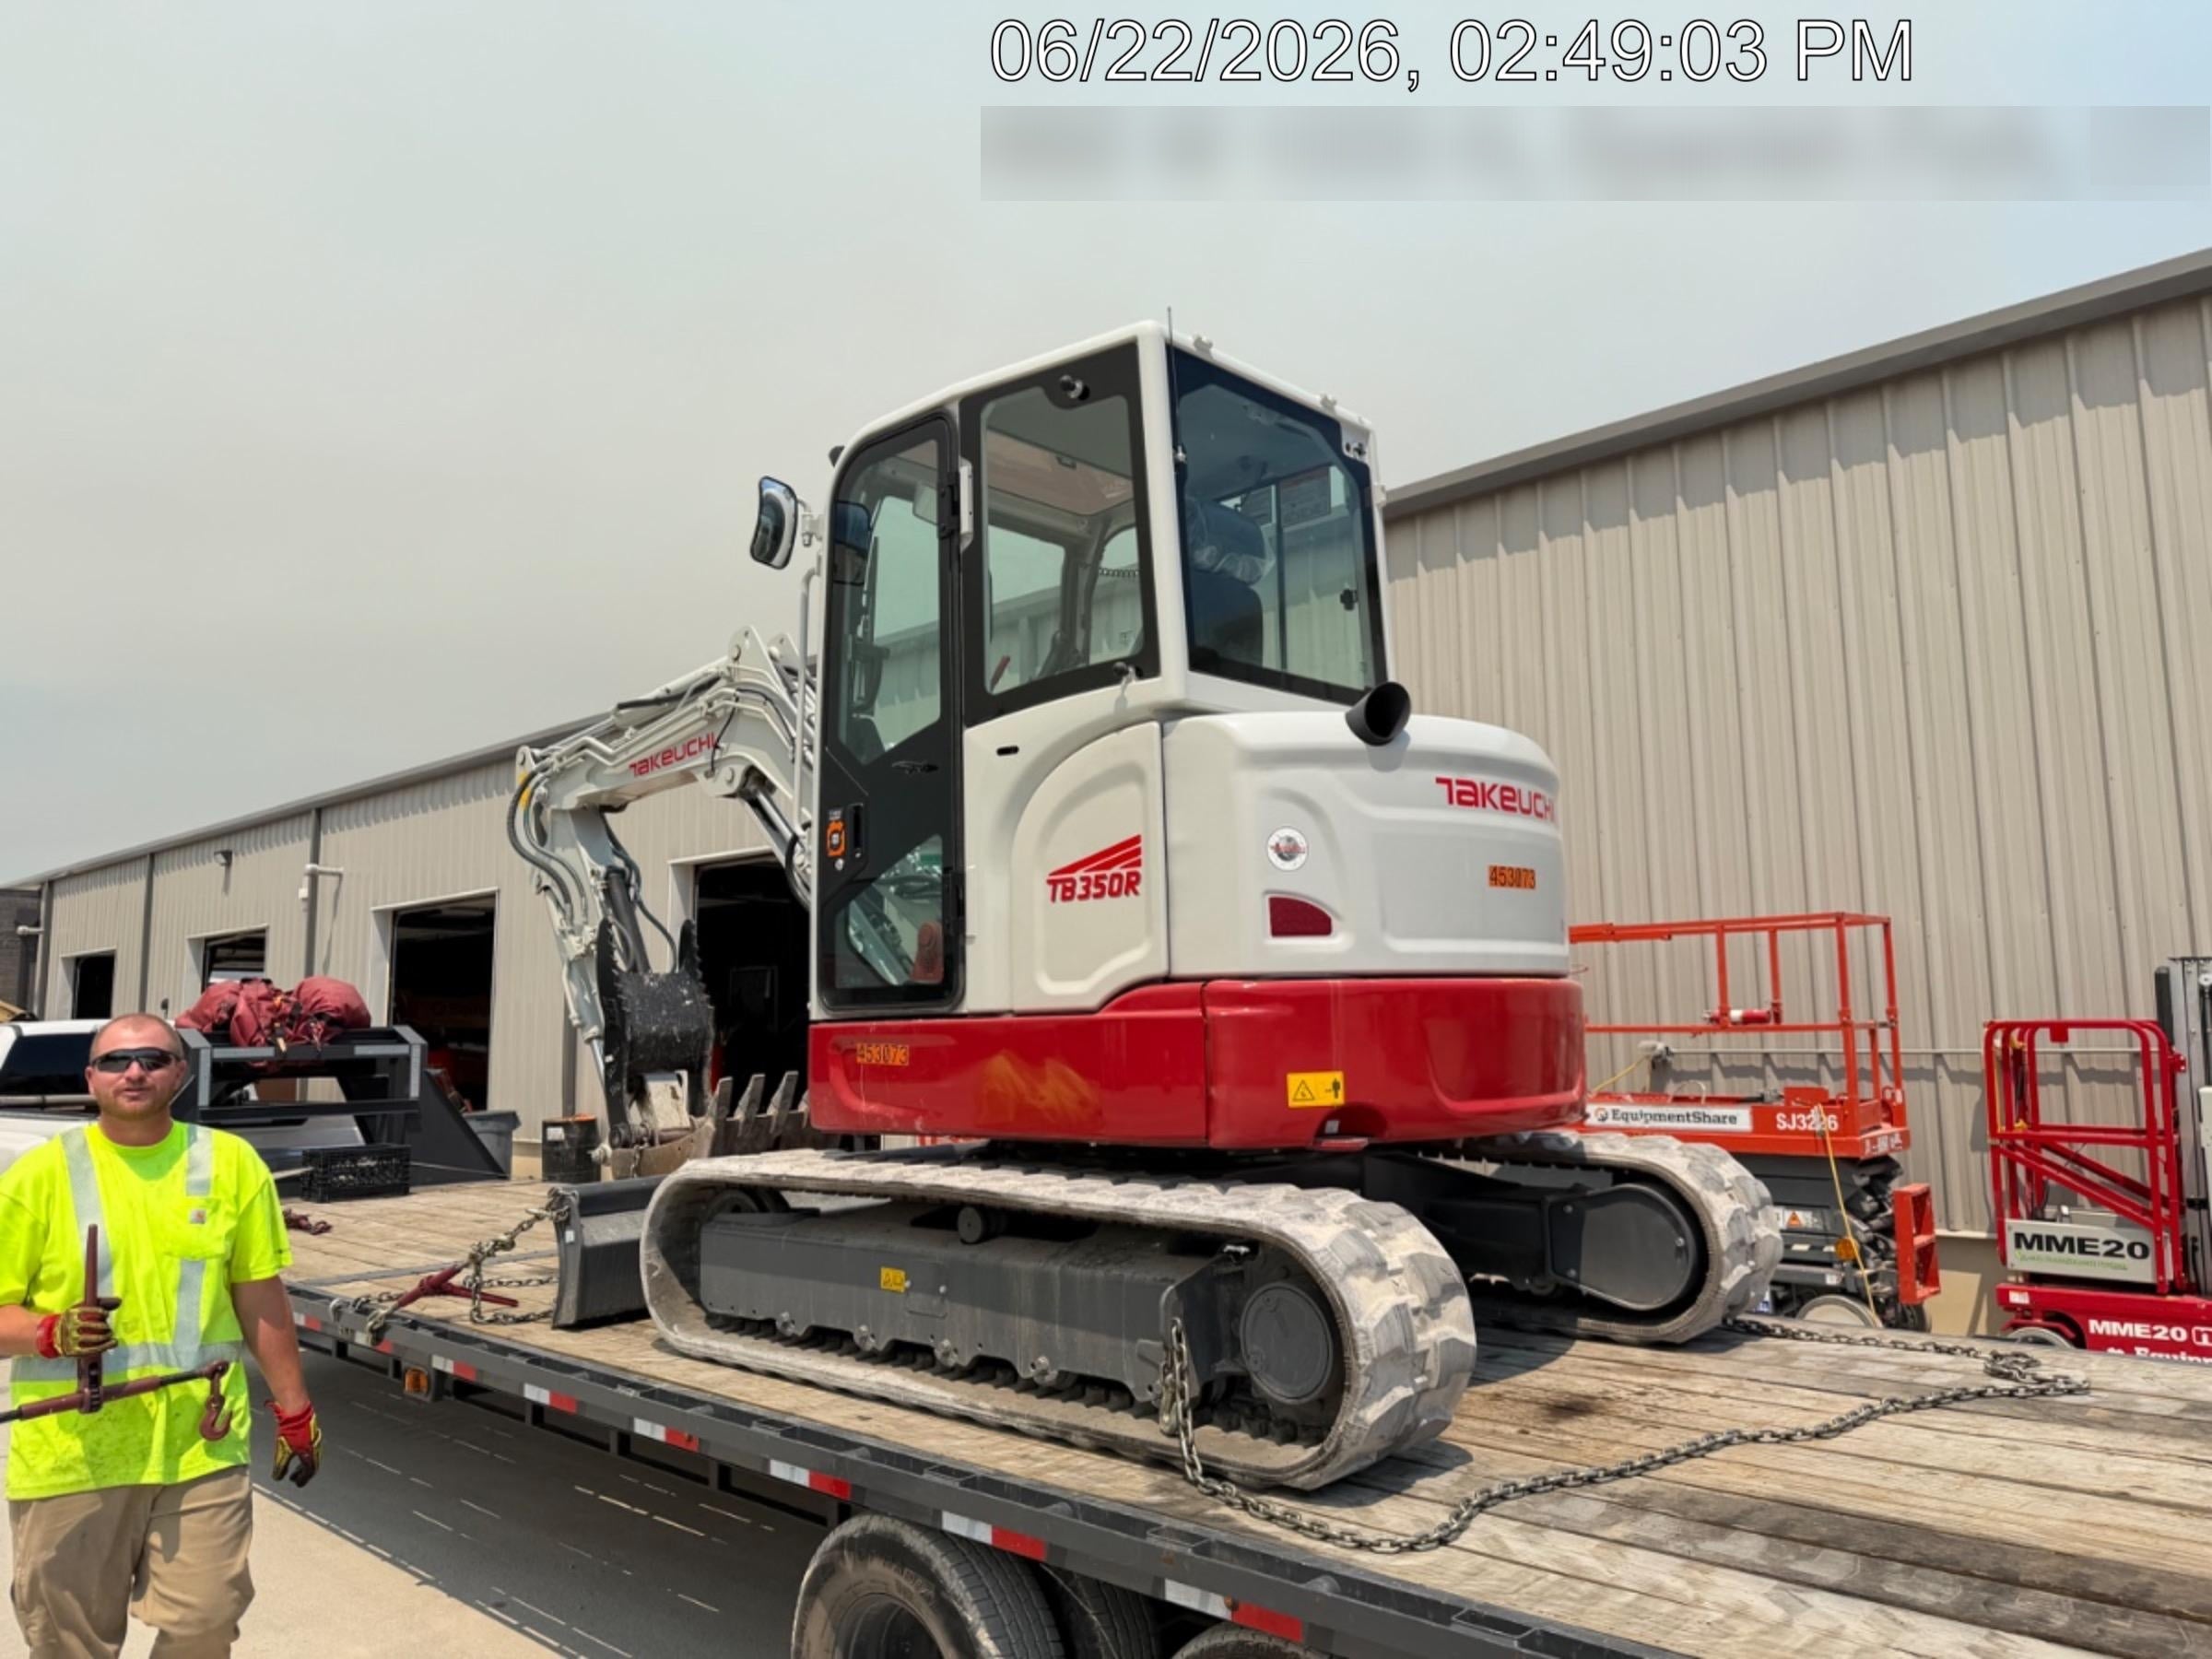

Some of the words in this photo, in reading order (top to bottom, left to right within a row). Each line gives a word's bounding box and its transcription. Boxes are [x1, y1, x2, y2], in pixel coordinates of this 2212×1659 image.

[1435, 776, 1558, 823] TAKEUCH
[1046, 870, 1142, 903] TB350R
[1488, 865, 1536, 889] 453073
[856, 1043, 909, 1065] 453073
[1610, 1108, 1738, 1127] EquipmentShare
[2014, 1231, 2150, 1260] MME20
[2088, 1319, 2188, 1342] MME20
